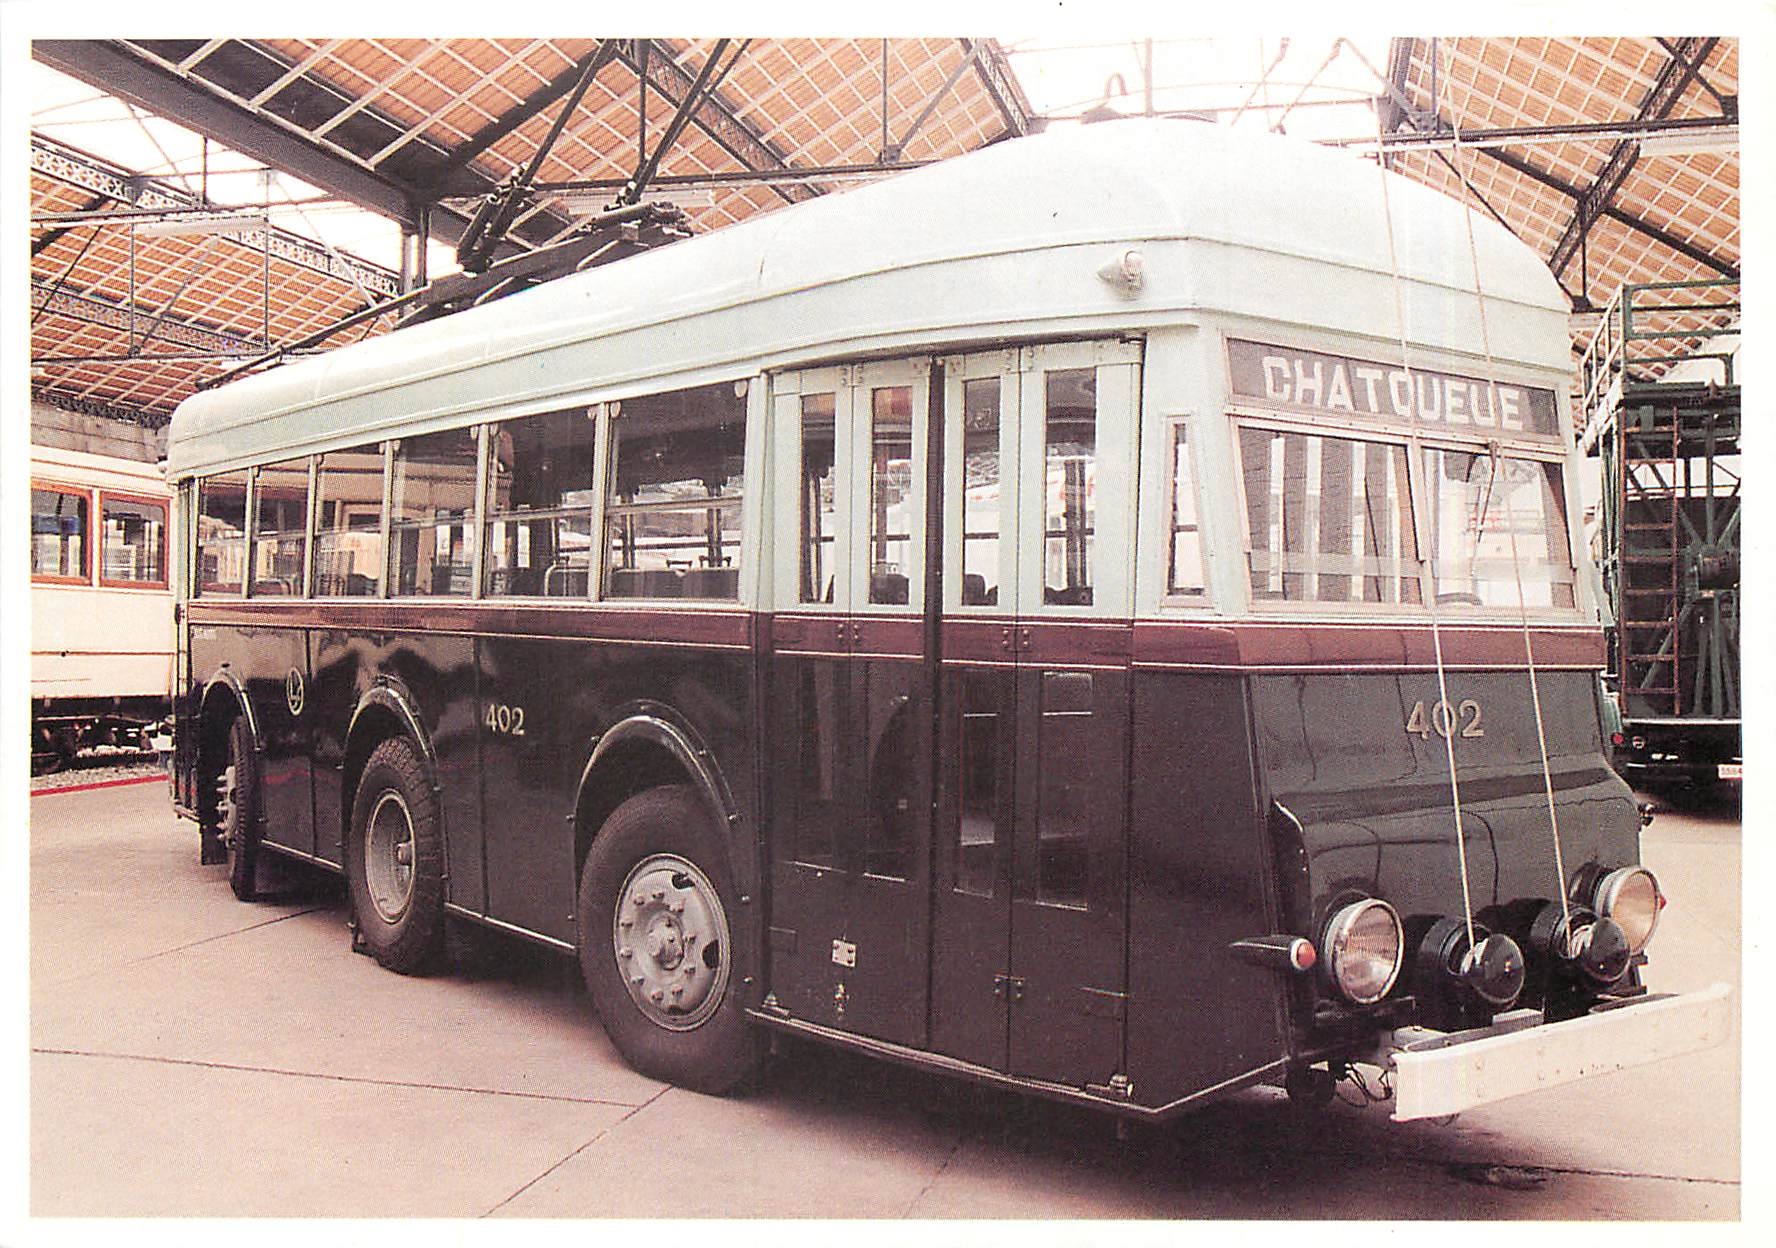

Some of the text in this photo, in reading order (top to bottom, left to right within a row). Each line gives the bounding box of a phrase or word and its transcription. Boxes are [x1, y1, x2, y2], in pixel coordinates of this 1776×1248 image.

[1262, 356, 1523, 431] CHATQUEUE
[485, 703, 526, 735] 402
[1406, 699, 1484, 739] 402
